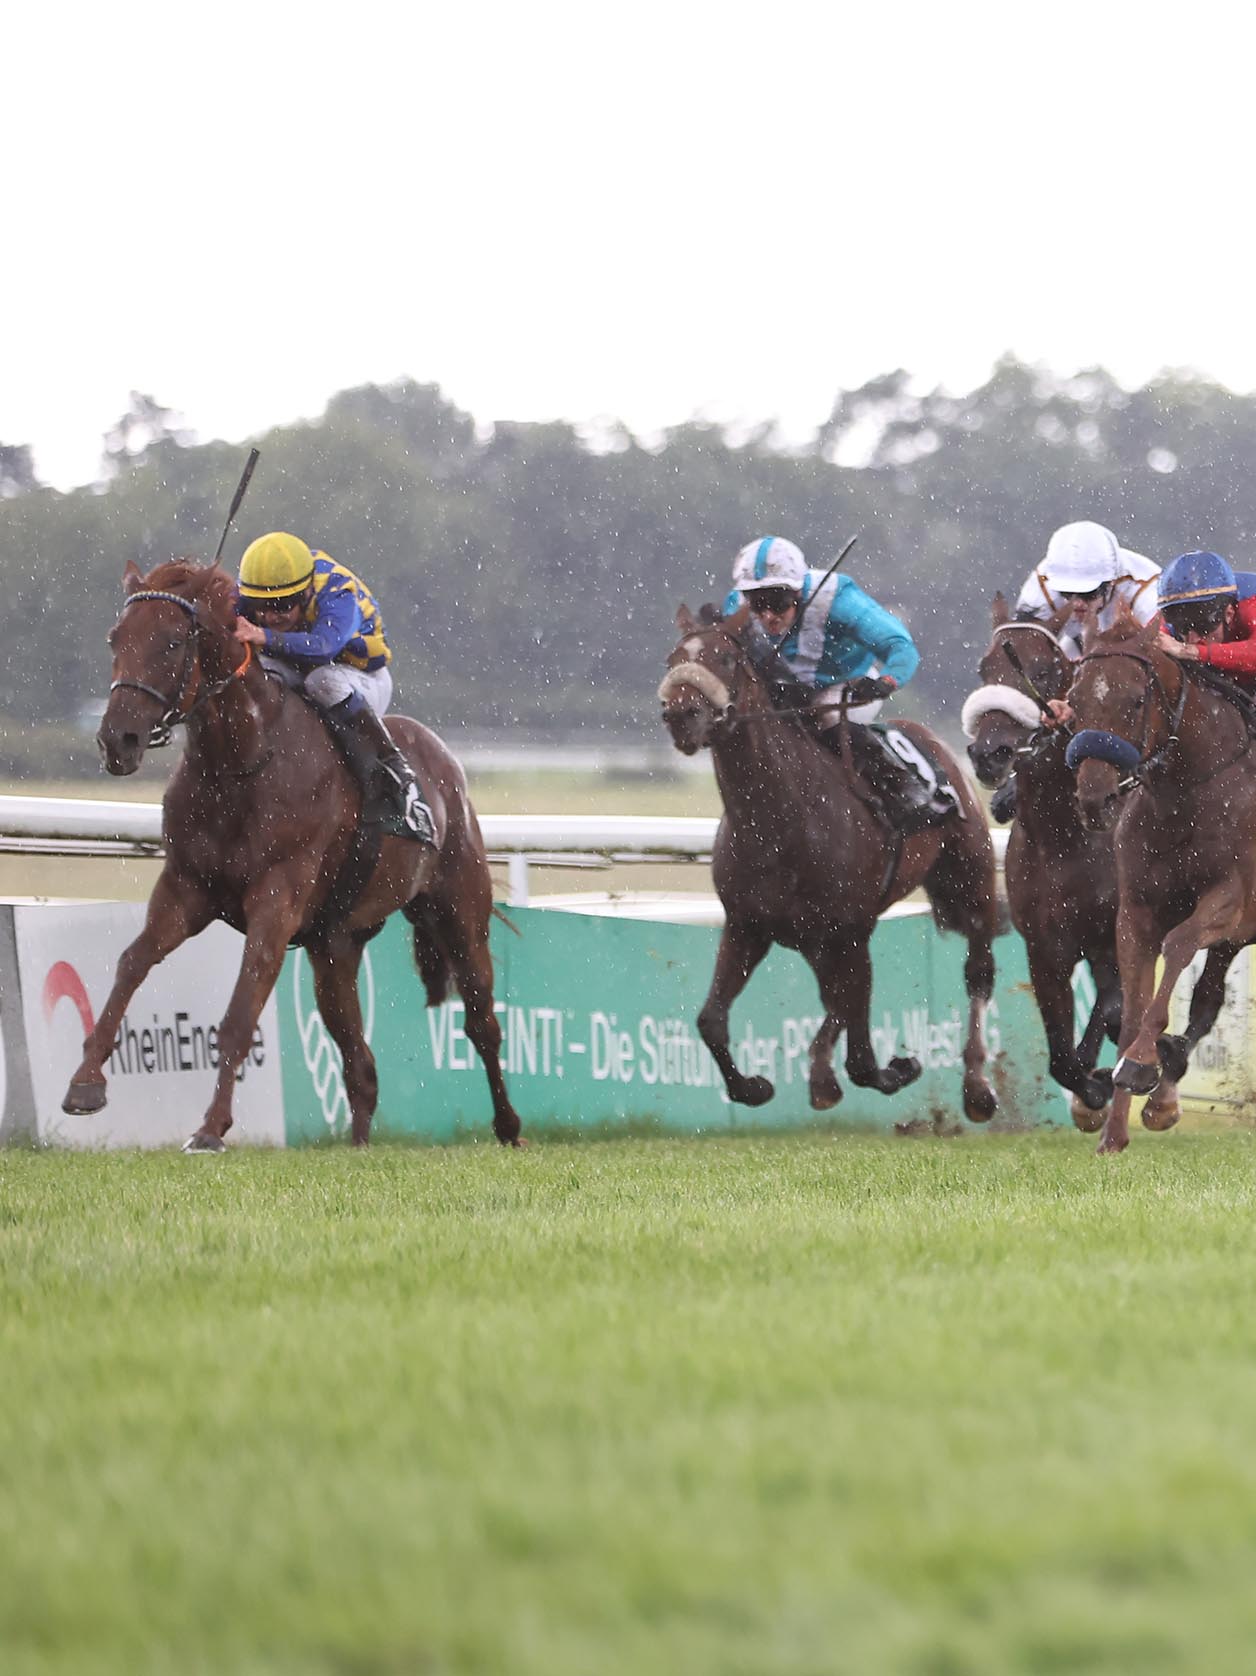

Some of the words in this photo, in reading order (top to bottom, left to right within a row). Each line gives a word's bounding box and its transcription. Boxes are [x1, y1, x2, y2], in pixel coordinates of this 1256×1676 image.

[110, 1012, 265, 1082] RheinEnee
[426, 1000, 564, 1078] VEEINT!
[589, 1011, 635, 1082] Die
[638, 1014, 731, 1103] Stiftu
[782, 1014, 836, 1084] PS
